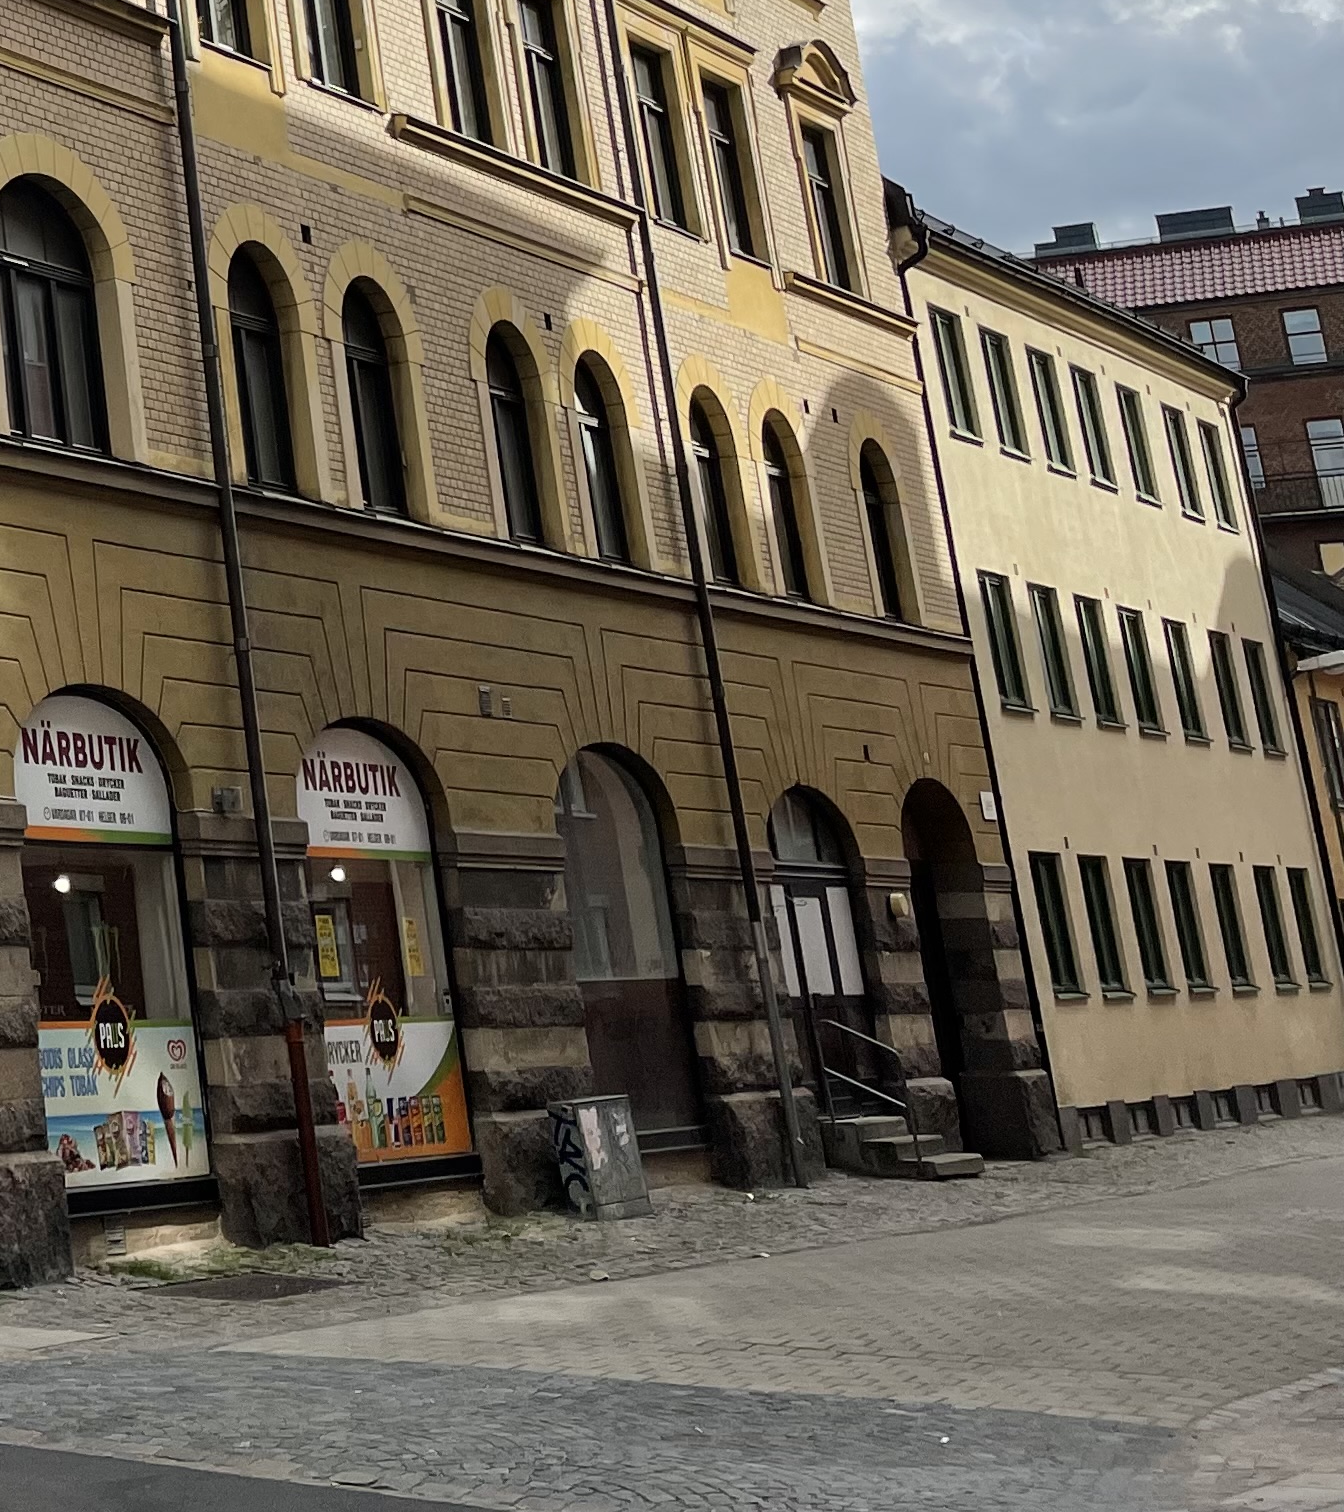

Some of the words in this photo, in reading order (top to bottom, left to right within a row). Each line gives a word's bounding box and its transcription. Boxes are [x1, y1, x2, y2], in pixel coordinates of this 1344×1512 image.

[21, 720, 143, 774] NÄRBUTIK
[302, 751, 401, 797] NÄRBUTIK
[68, 1047, 94, 1069] GLASS
[70, 1075, 98, 1096] TOBAK
